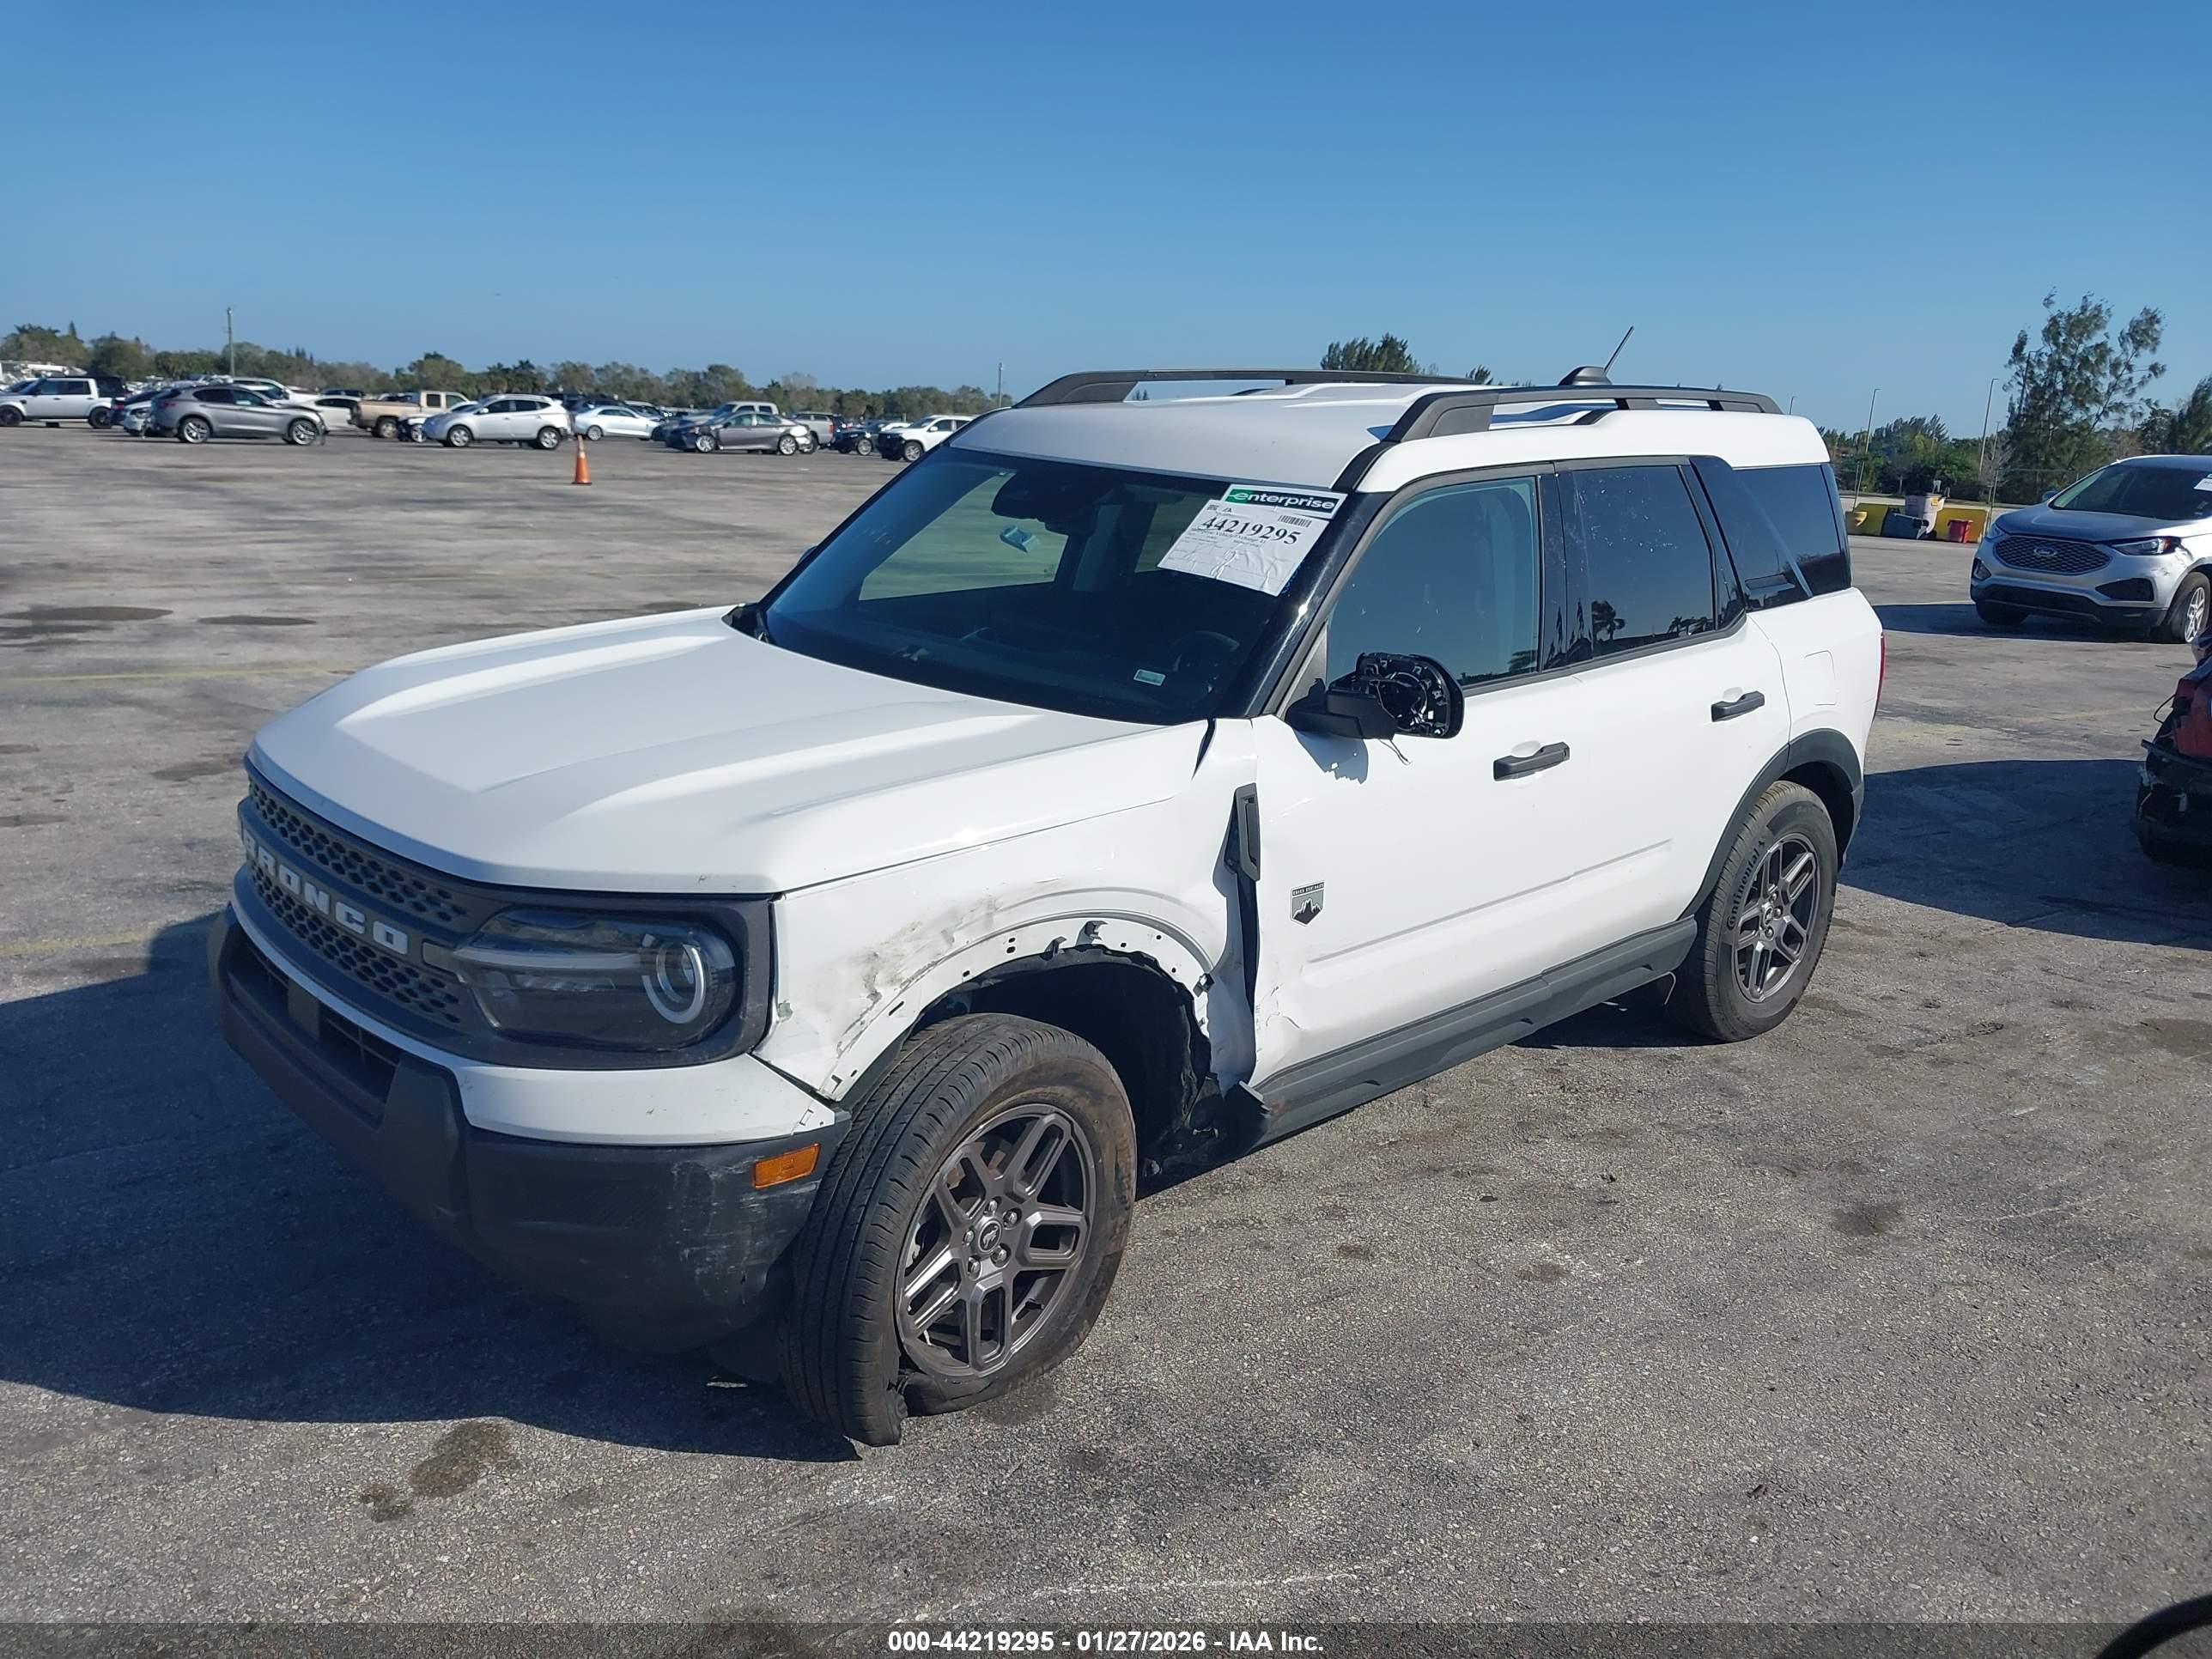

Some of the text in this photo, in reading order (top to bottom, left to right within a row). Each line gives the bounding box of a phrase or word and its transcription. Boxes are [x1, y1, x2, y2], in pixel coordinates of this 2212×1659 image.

[1230, 491, 1335, 510] enterprise
[1201, 516, 1302, 545] 44219295
[243, 828, 408, 955] BRONCO
[1727, 848, 1759, 930] Continental
